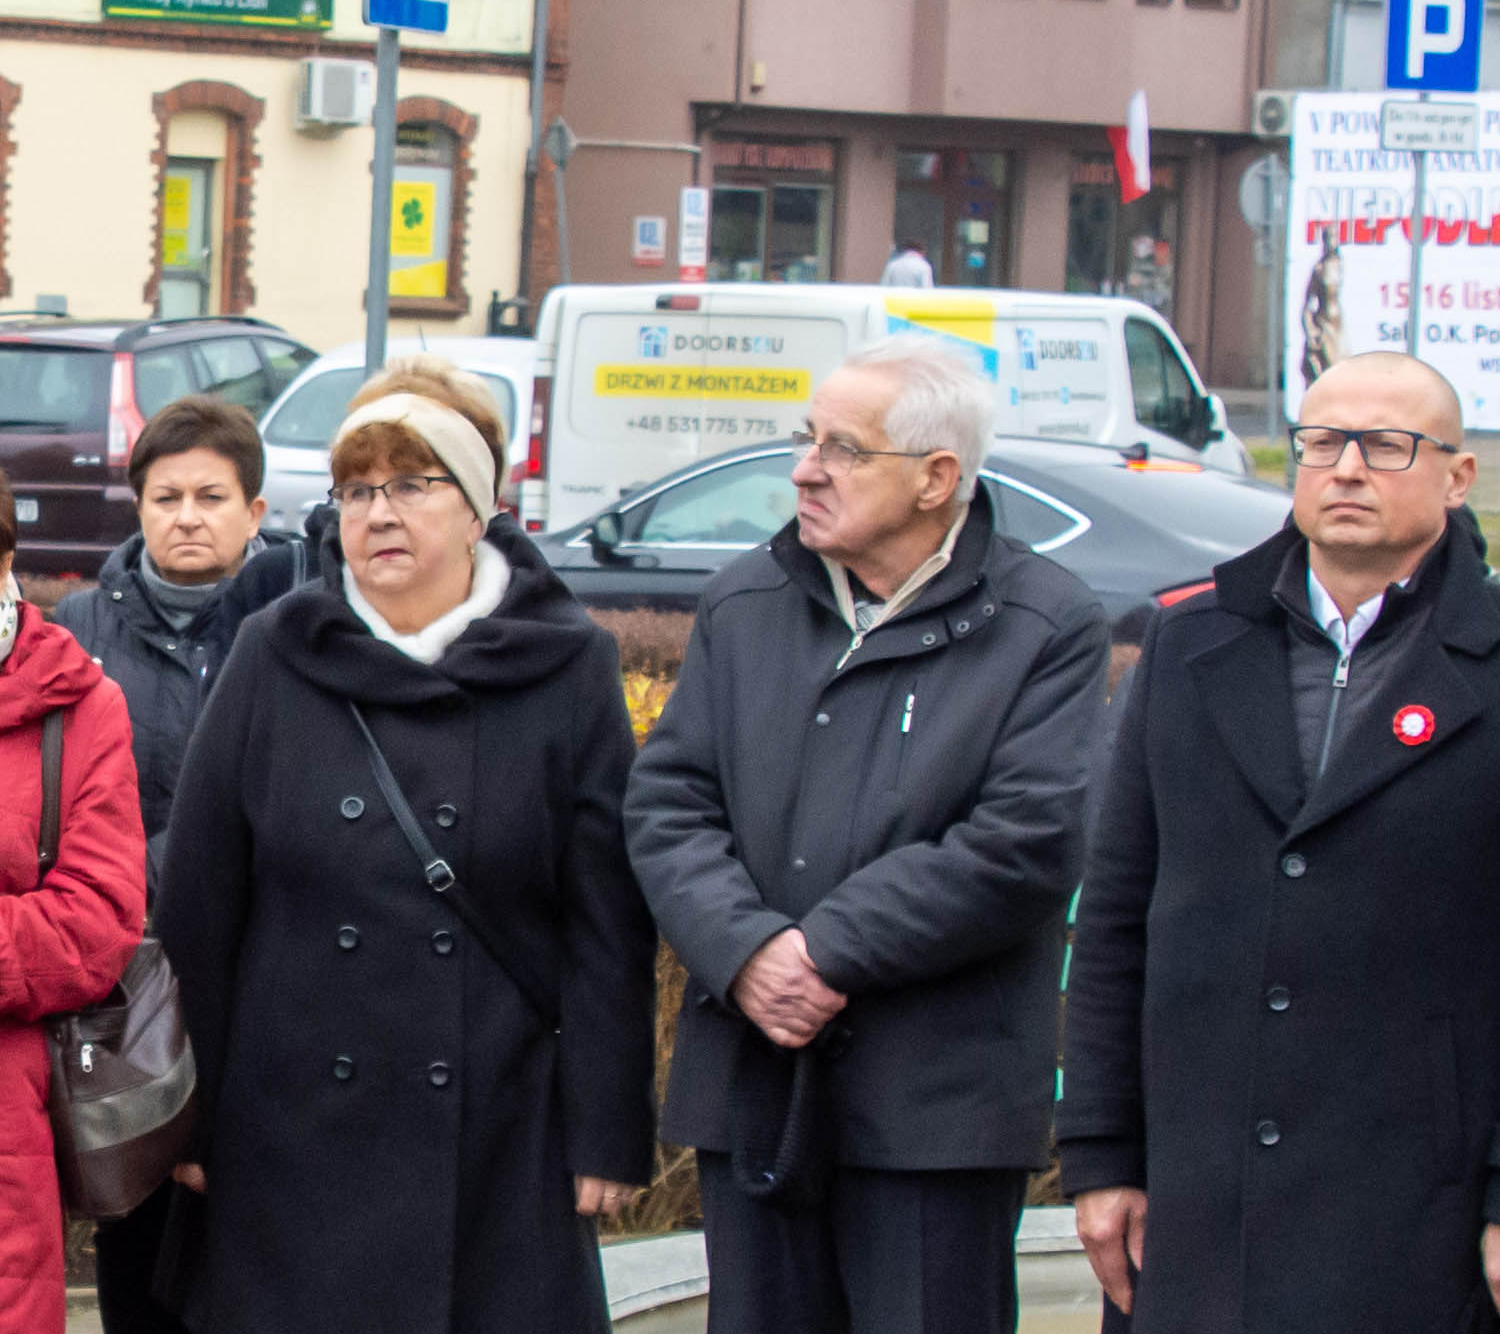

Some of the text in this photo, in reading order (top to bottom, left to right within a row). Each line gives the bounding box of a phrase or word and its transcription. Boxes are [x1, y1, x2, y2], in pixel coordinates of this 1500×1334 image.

[606, 372, 799, 394] DRZWI Z MONTAŻEM
[627, 416, 778, 436] +48 531 775 775
